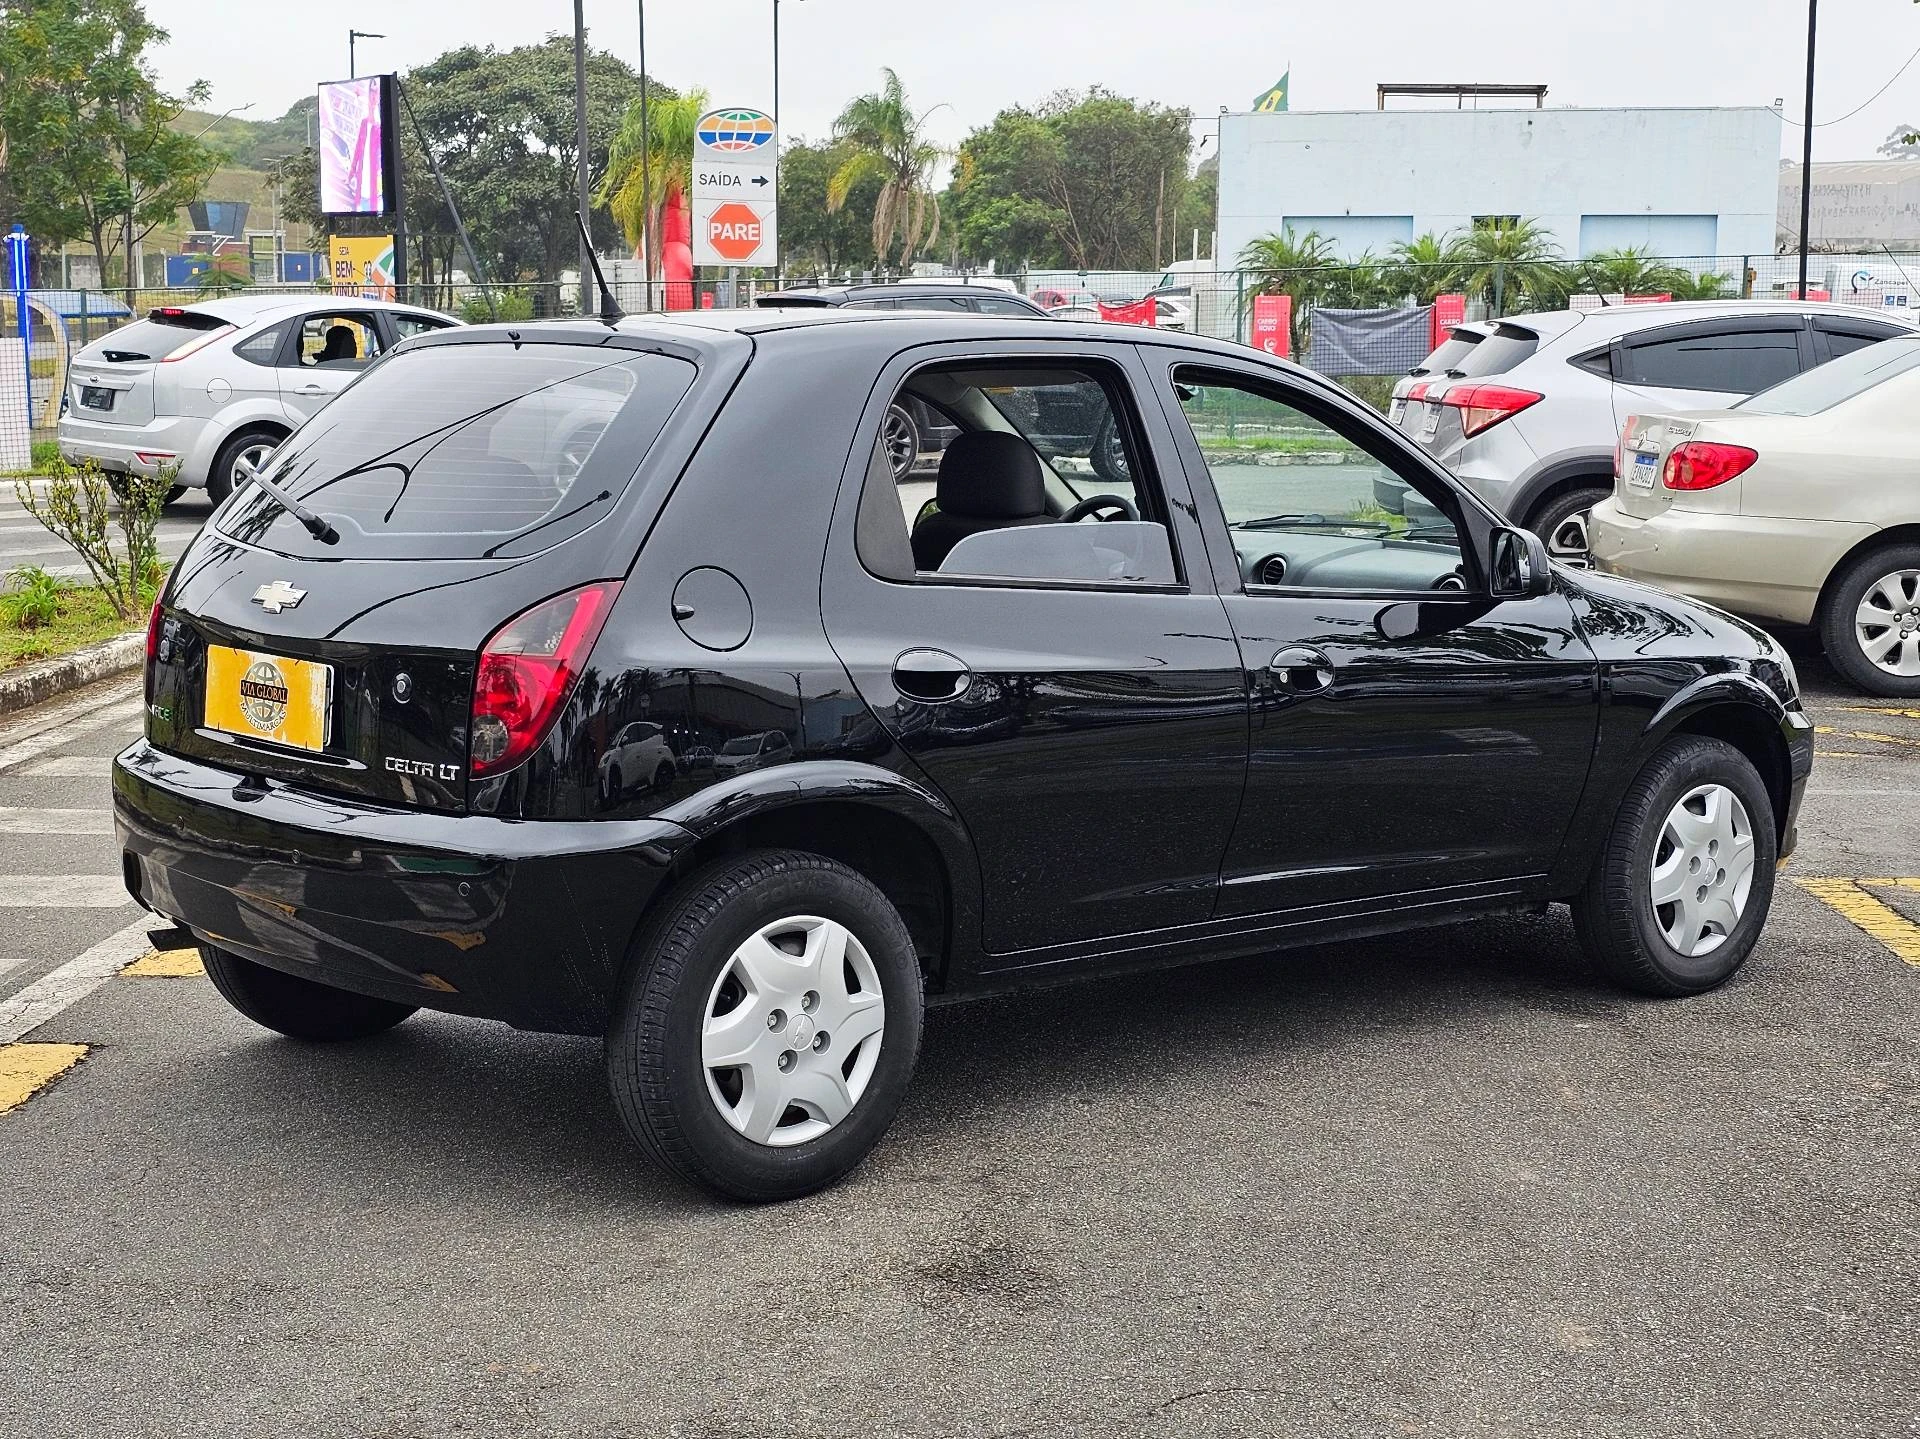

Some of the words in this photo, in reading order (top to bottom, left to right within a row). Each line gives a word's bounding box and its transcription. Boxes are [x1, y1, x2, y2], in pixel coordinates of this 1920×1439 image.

[699, 170, 742, 187] SAÍDA
[710, 222, 760, 241] PARE
[335, 260, 356, 278] BEM-
[333, 281, 359, 298] VINDO
[242, 682, 255, 696] VIA
[256, 685, 287, 703] GLOBAL
[240, 701, 287, 732] MULTIMARCAS
[385, 756, 434, 777] CELTA
[440, 763, 460, 781] LT
